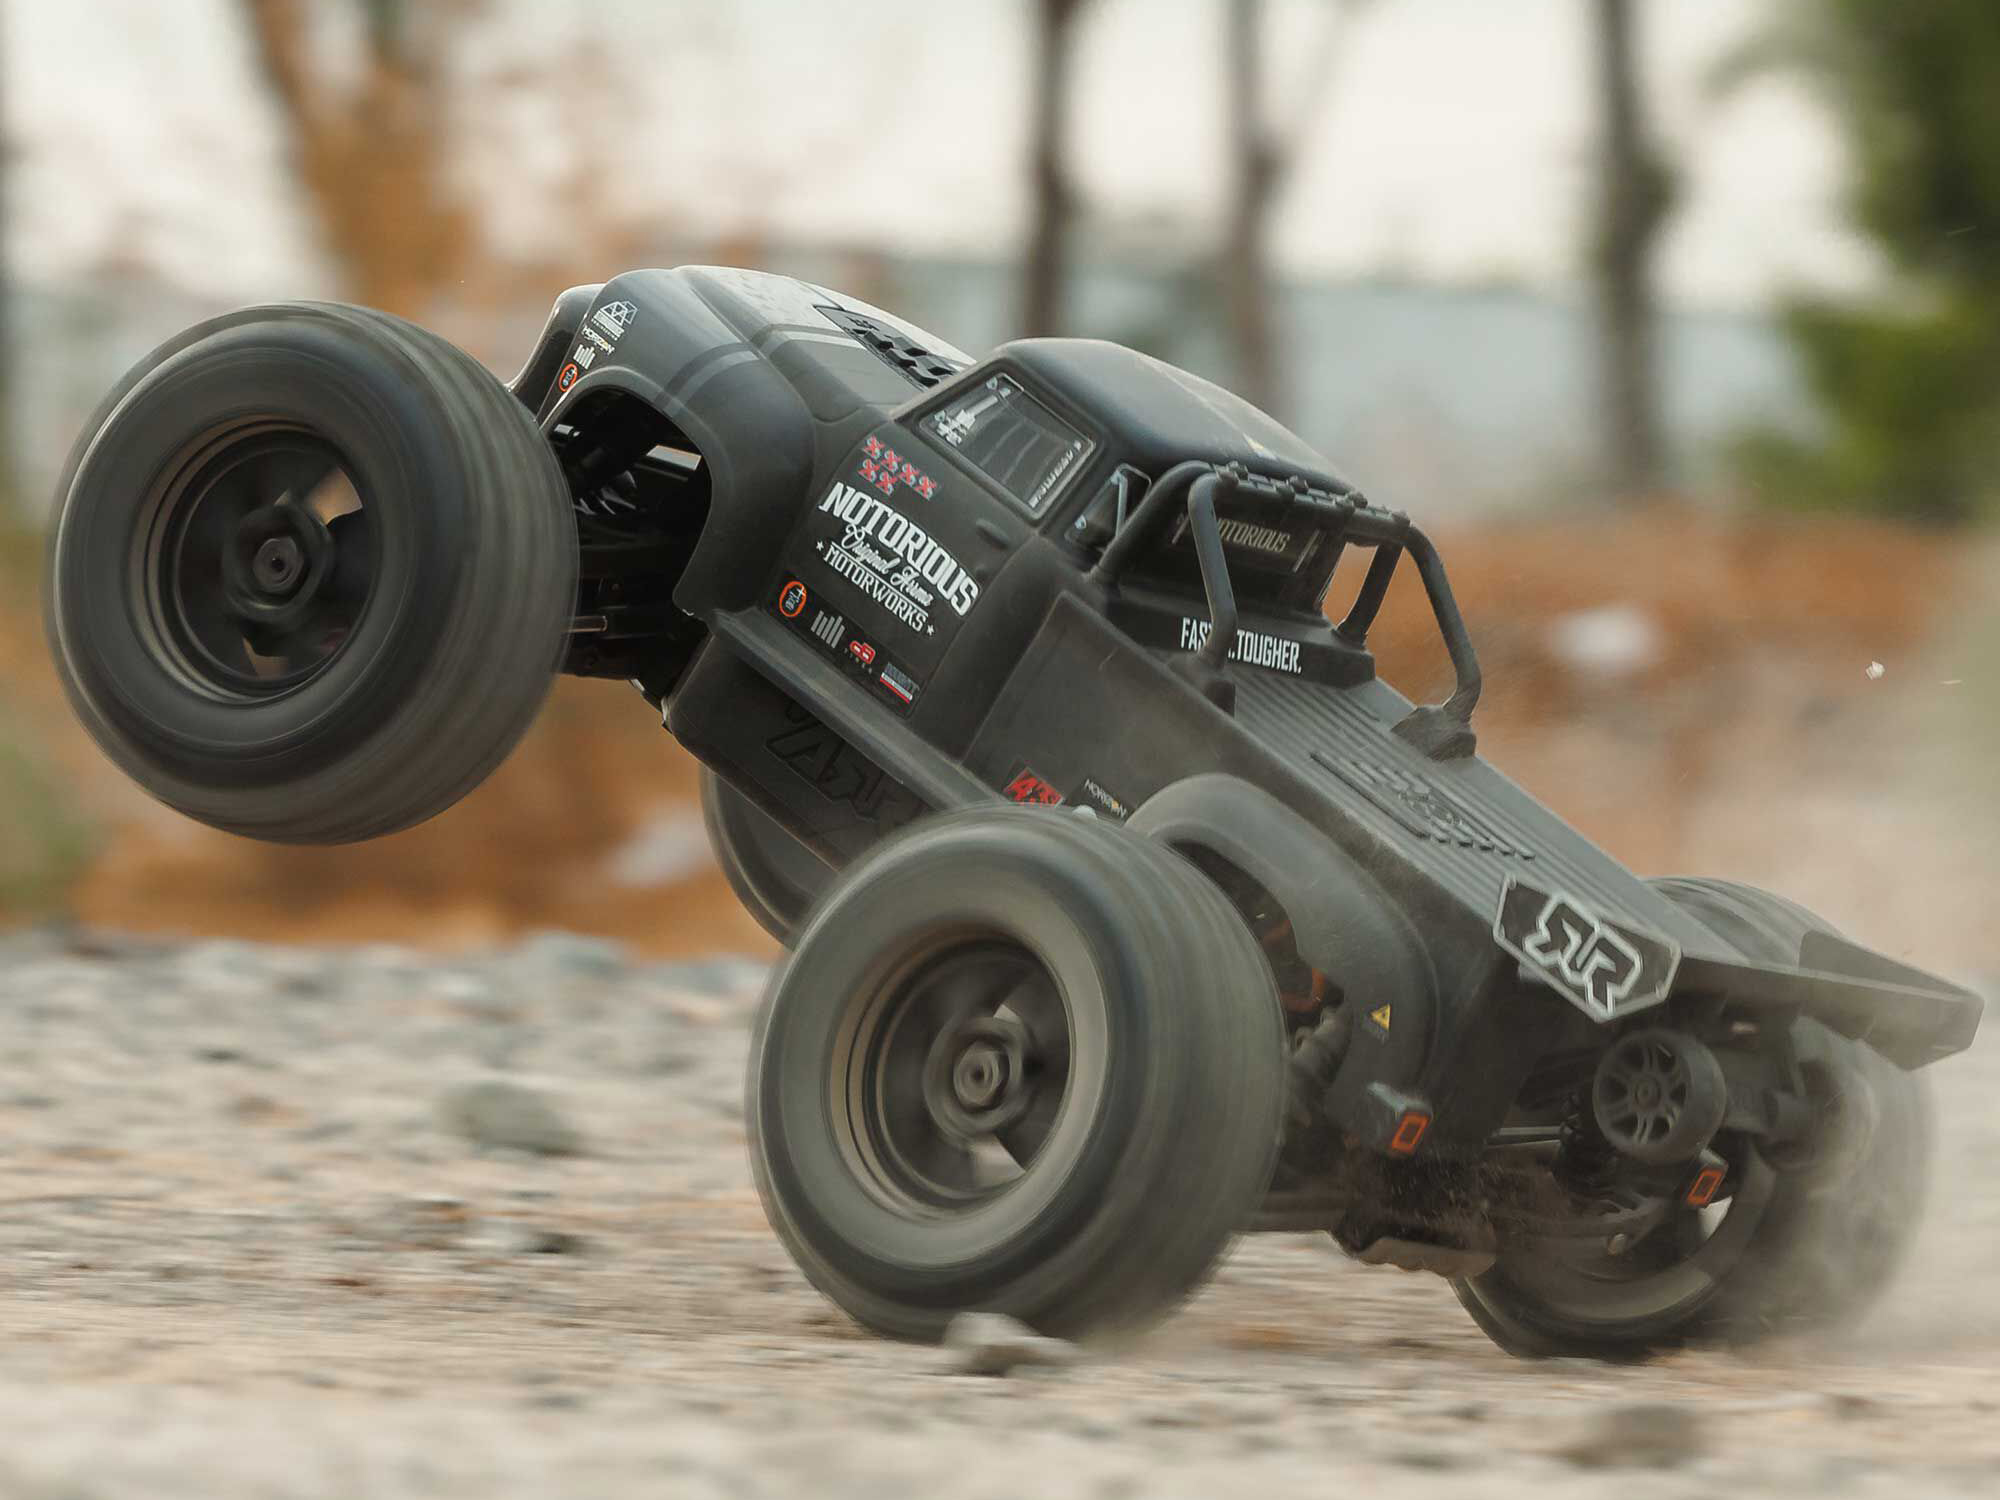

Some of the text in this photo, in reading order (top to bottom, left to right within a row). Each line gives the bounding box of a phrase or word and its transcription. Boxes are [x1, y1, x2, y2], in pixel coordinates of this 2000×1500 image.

[818, 481, 979, 616] NOTORIOUS
[841, 524, 900, 575] Original
[1217, 517, 1290, 552] OTORIOUS
[823, 544, 927, 632] MOTORWORKS
